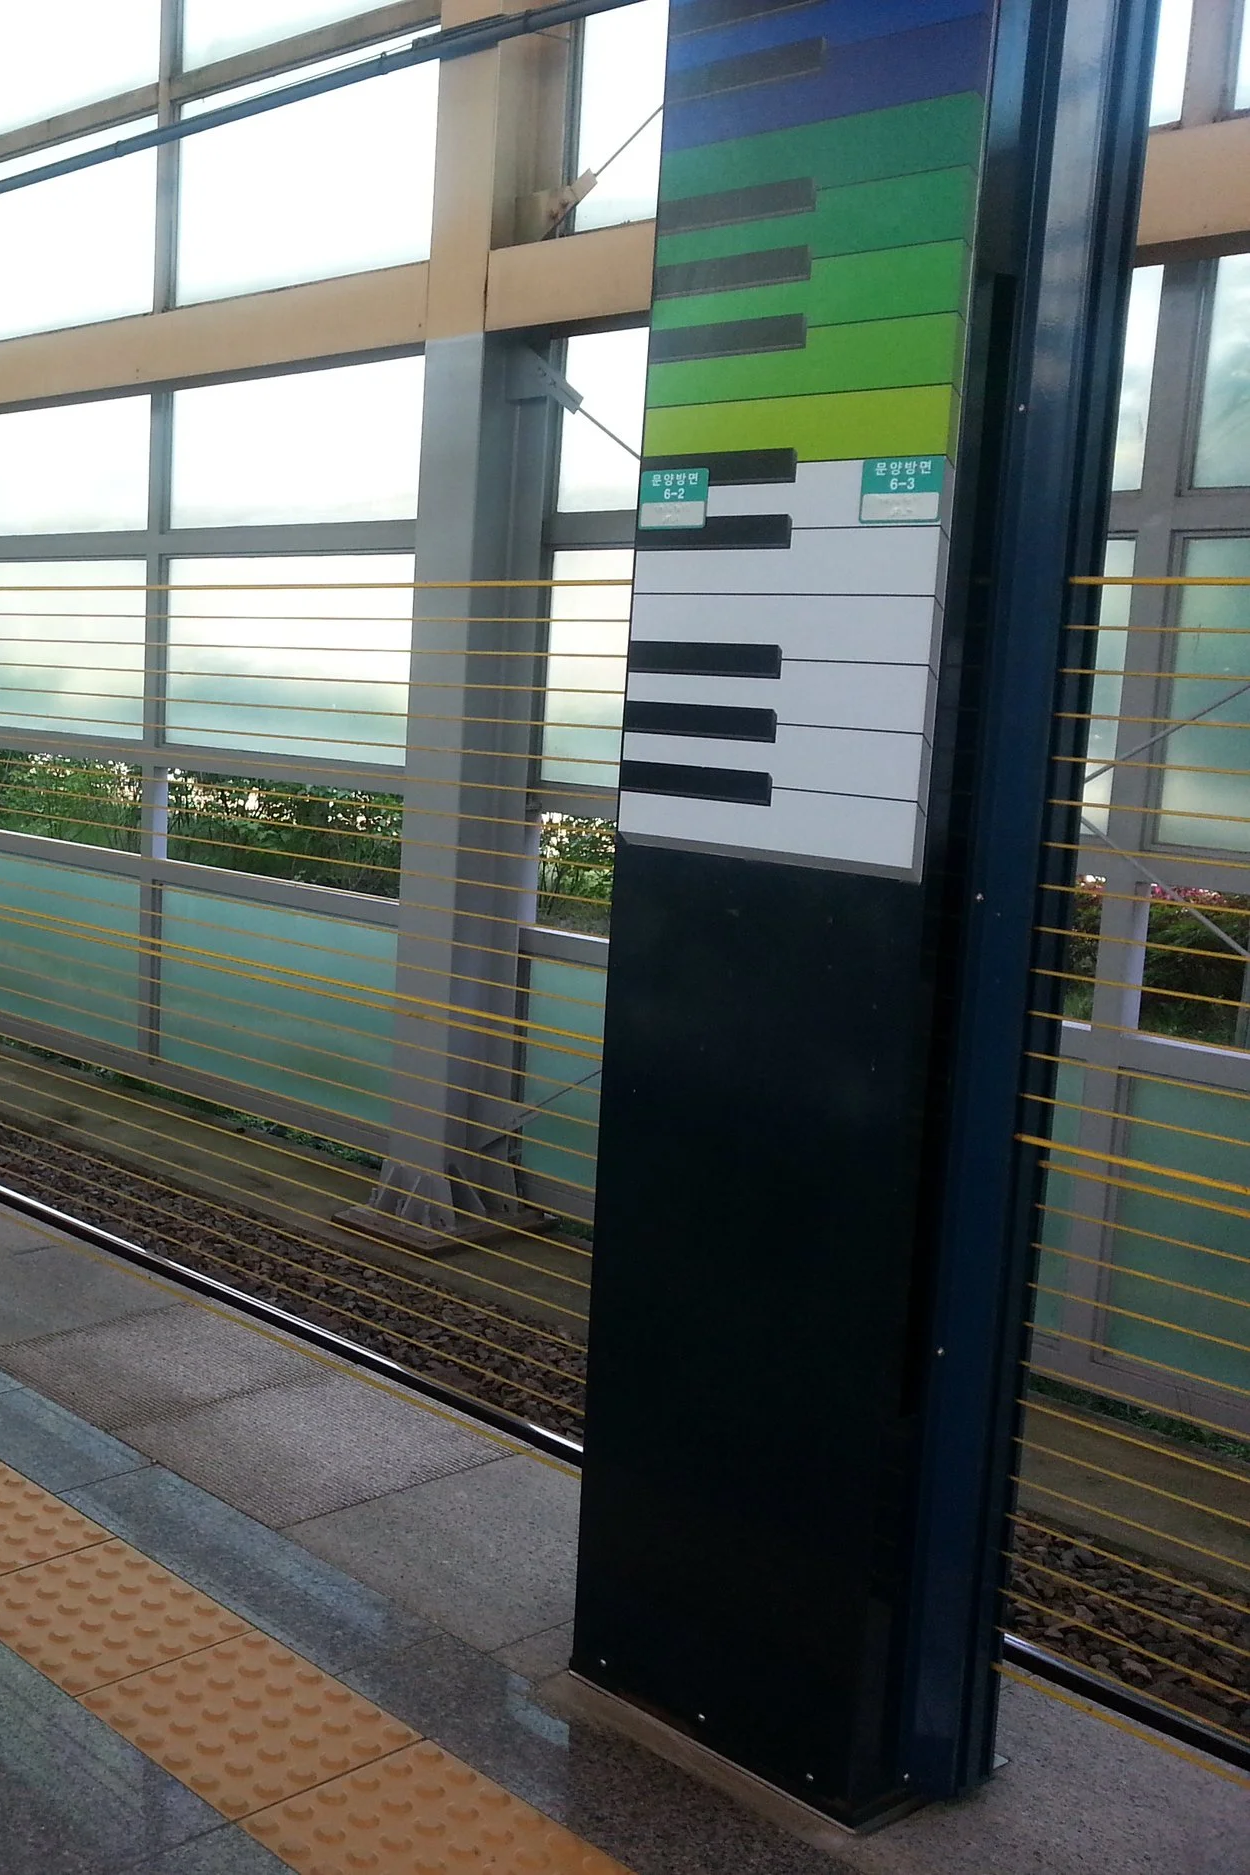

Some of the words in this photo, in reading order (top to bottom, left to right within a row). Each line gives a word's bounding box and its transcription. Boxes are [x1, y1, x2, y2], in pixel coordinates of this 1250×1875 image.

[875, 460, 932, 476] 문양방면
[651, 472, 699, 487] 문양방면
[889, 477, 915, 490] 6-3
[663, 488, 685, 500] 6-2
